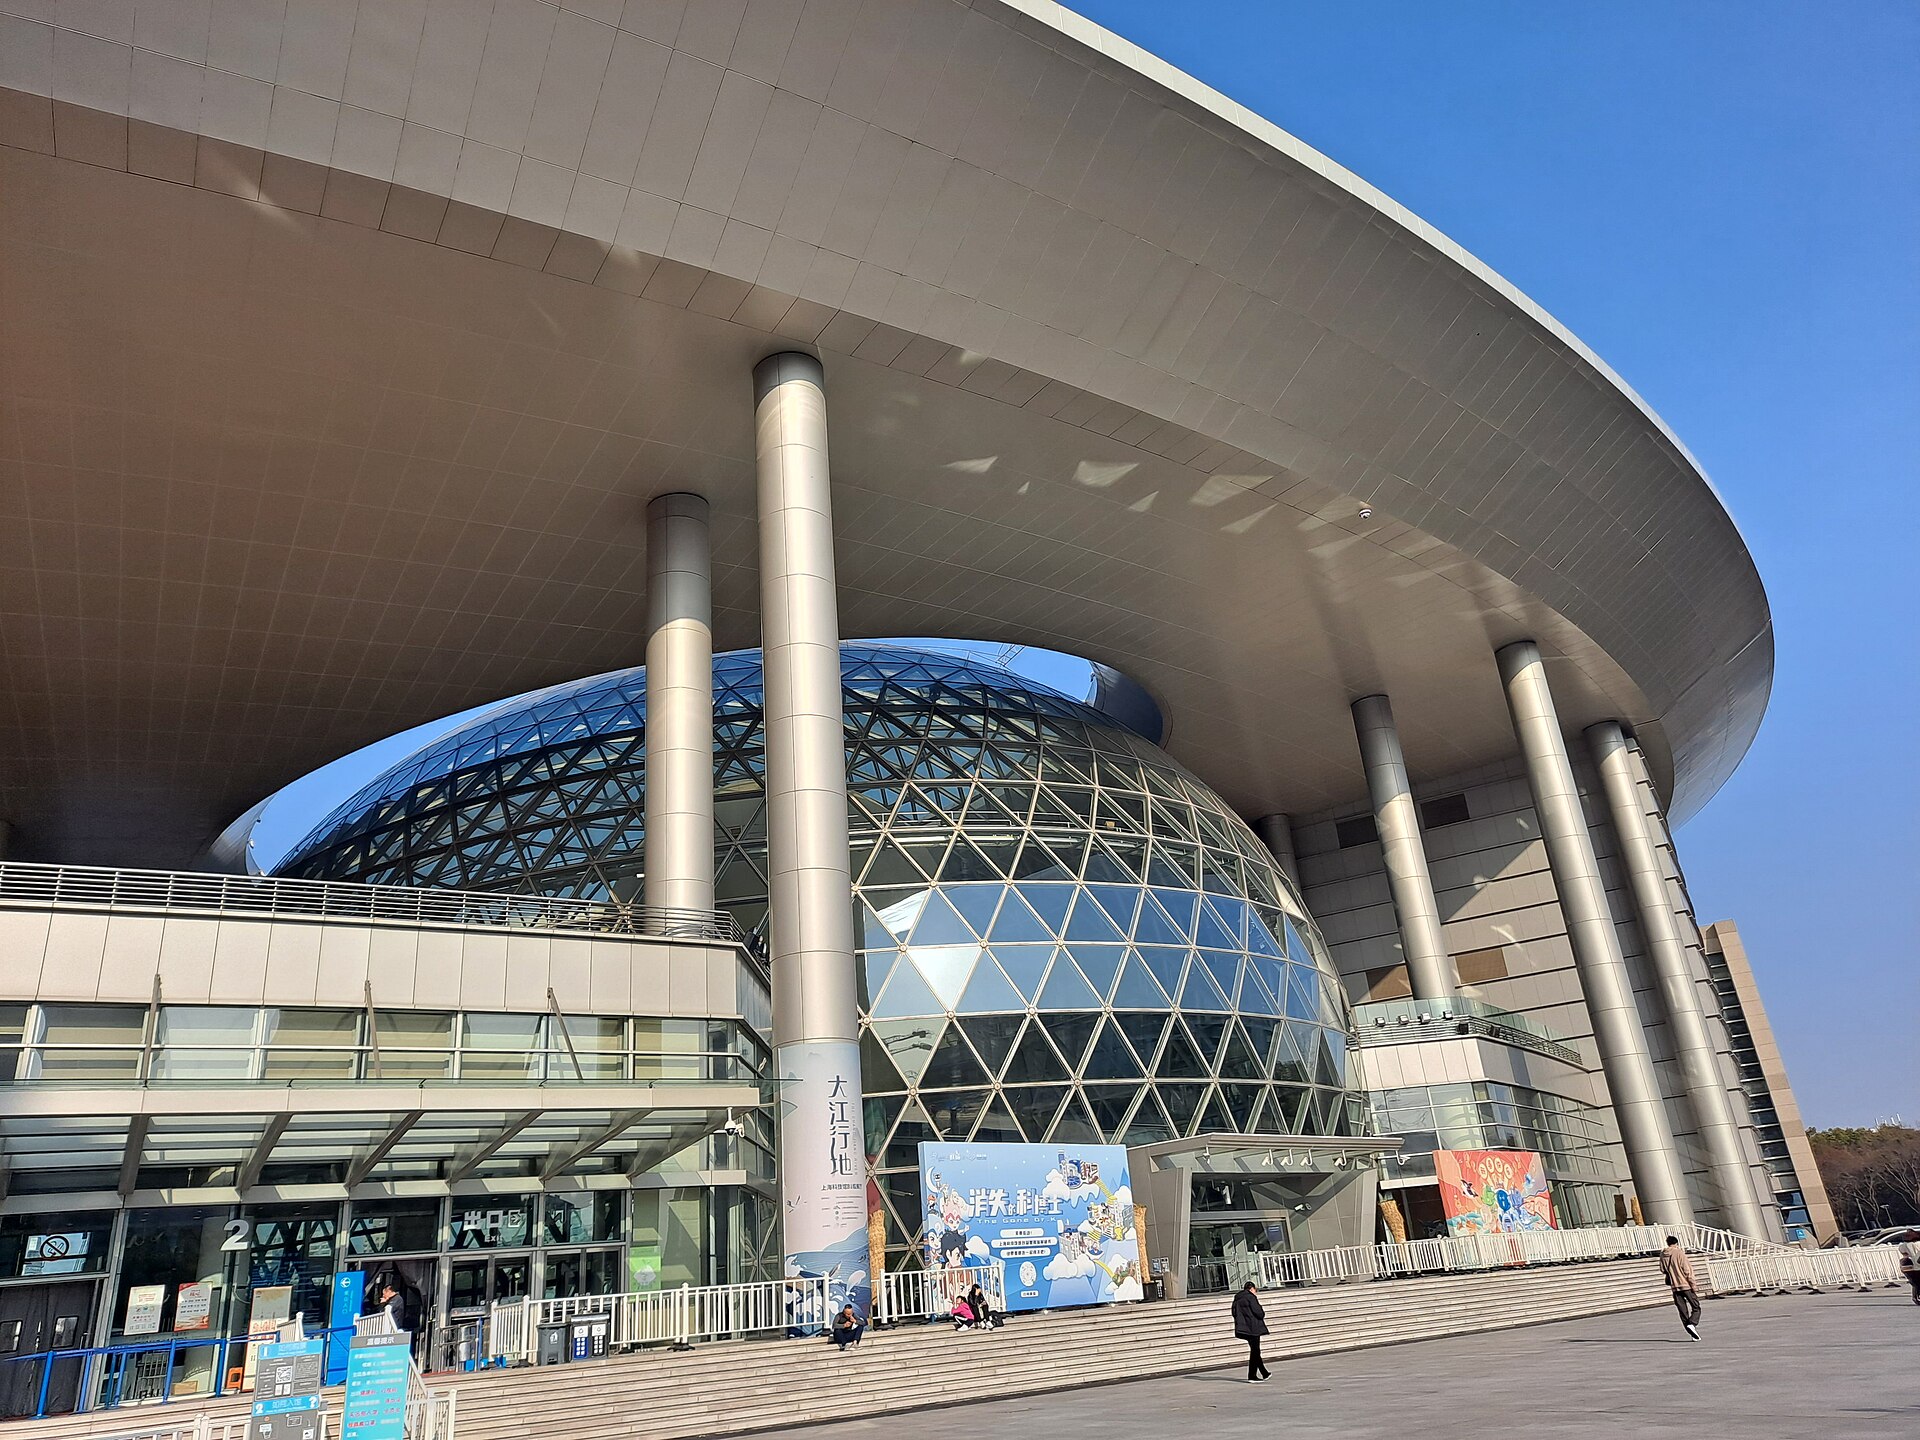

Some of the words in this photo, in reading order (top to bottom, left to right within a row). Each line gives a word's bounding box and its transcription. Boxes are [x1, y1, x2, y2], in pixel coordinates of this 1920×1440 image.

[828, 1075, 853, 1175] 大江行地
[968, 1188, 1063, 1218] 消失的科博士
[220, 1219, 249, 1251] 2
[463, 1210, 503, 1231] 出口
